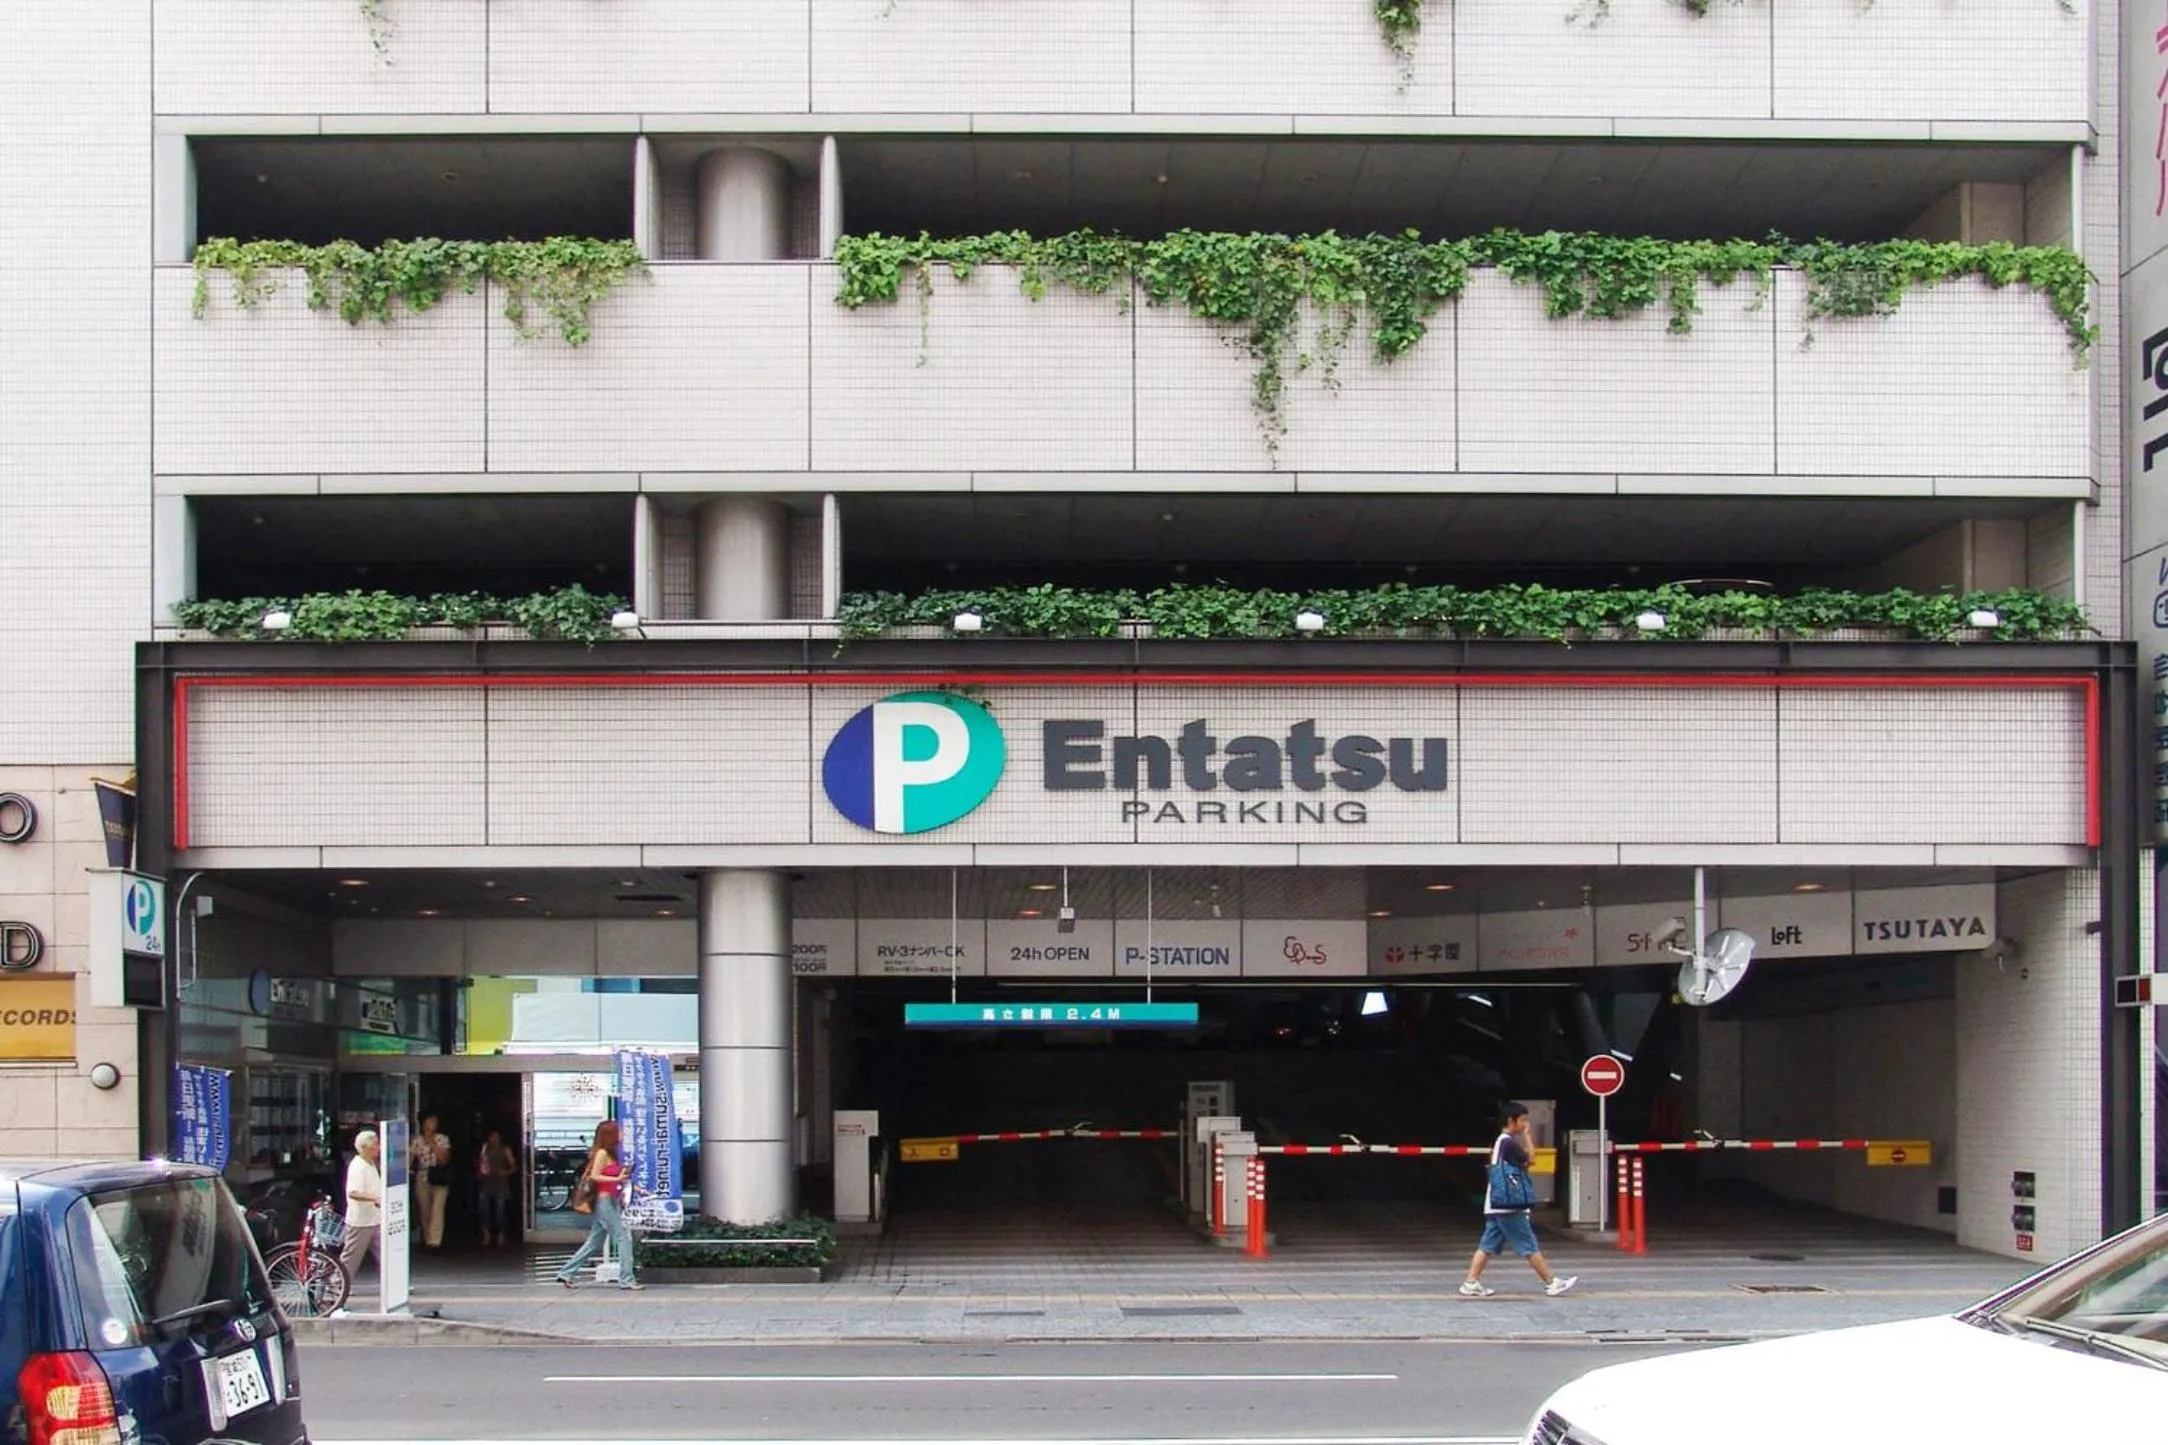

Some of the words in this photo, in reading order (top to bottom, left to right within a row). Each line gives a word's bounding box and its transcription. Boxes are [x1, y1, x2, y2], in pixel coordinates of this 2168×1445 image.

[1043, 718, 1448, 792] Entatsu
[1121, 801, 1368, 824] PARKING
[1864, 917, 1985, 940] TSUTAYA
[1044, 947, 1090, 961] OPEN
[1125, 947, 1230, 965] P-STATION
[0, 1010, 76, 1025] CORD
